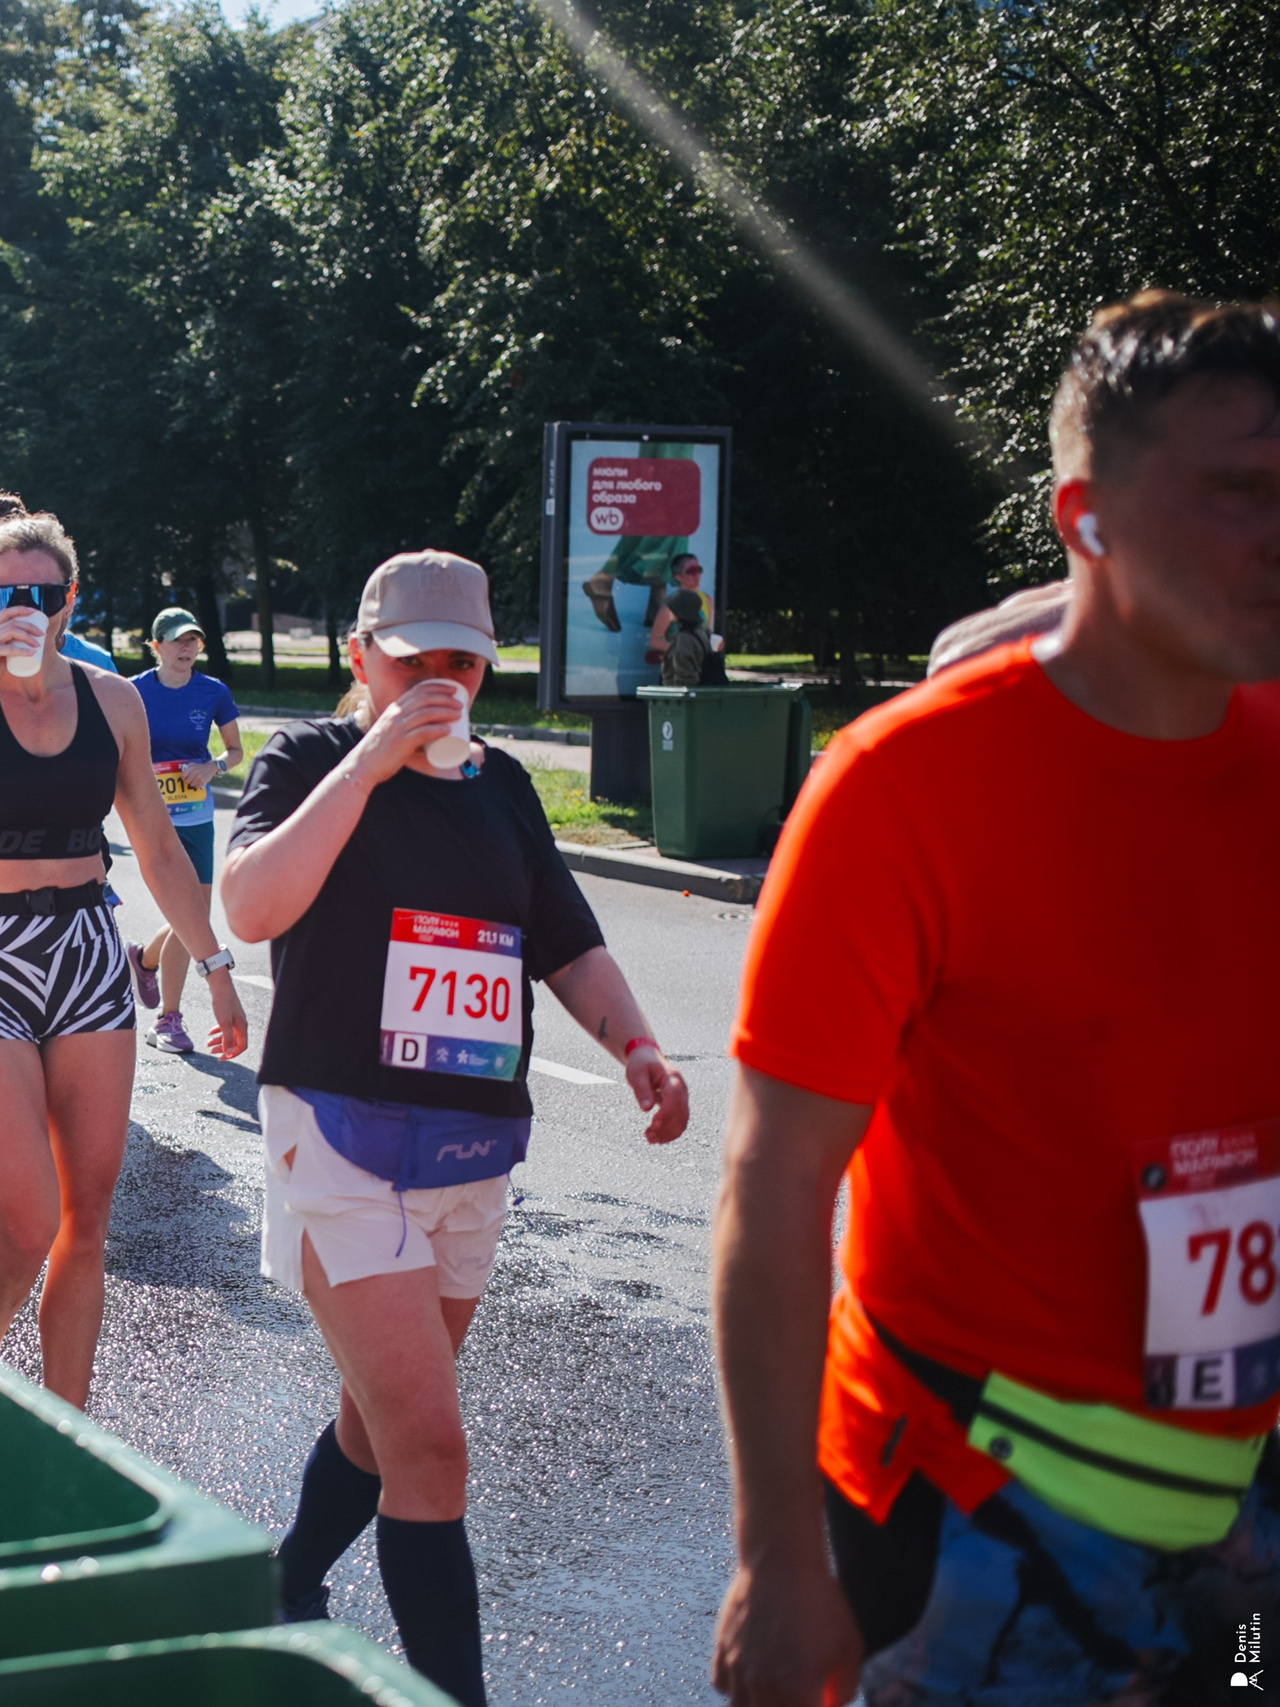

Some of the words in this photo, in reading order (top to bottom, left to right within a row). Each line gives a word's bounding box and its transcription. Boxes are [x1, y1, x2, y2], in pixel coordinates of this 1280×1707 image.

[593, 467, 629, 477] мюли
[592, 480, 615, 491] для
[616, 478, 663, 491] любого
[592, 490, 638, 505] образа
[595, 509, 620, 526] wb
[413, 914, 440, 926] ПОЛУ
[412, 924, 460, 939] МАРАФОН
[409, 965, 511, 1023] 7130
[400, 1037, 420, 1062] D
[1187, 1219, 1280, 1317] 78
[1193, 1358, 1224, 1402] E
